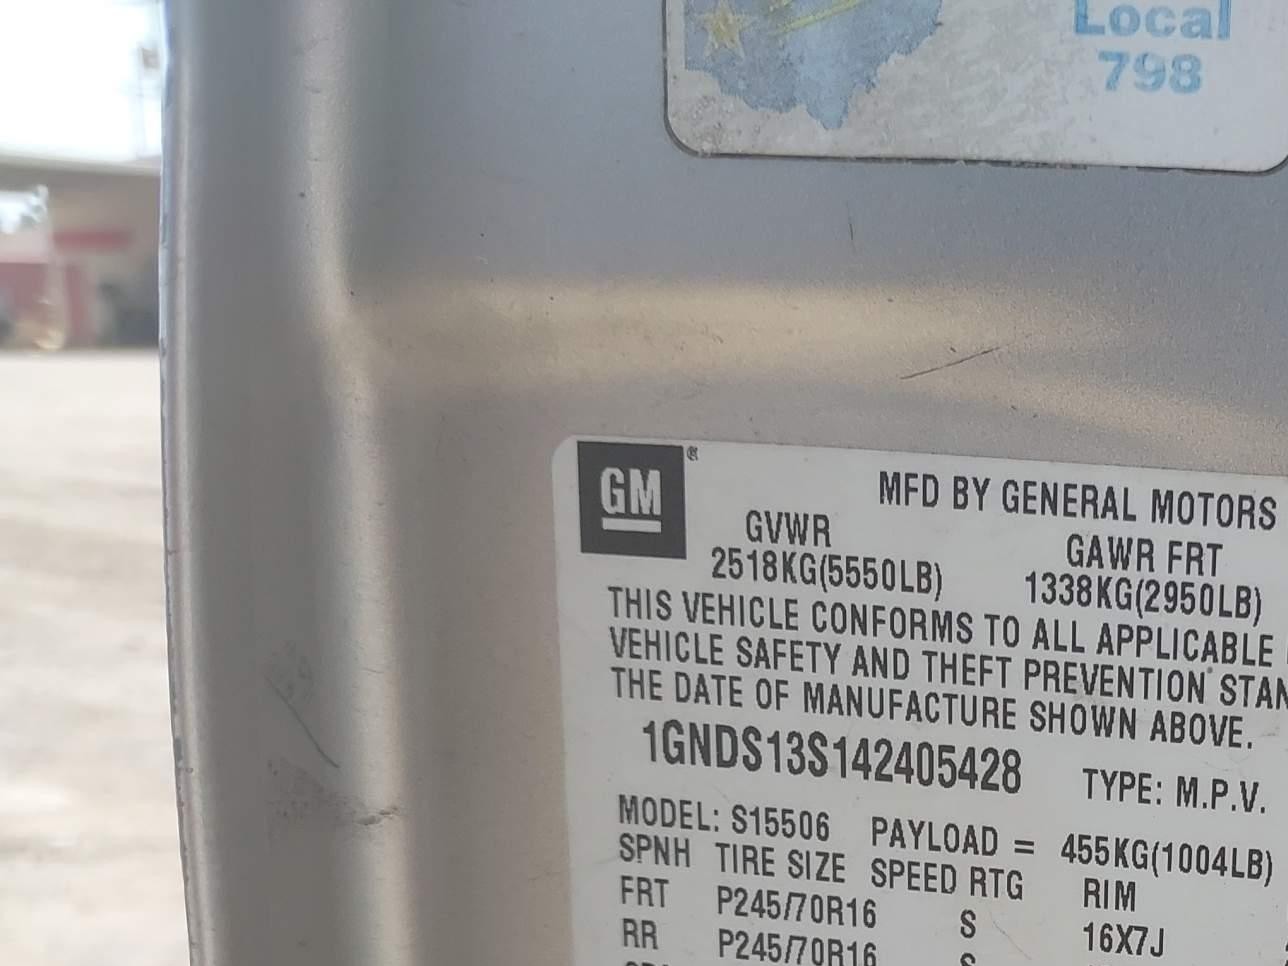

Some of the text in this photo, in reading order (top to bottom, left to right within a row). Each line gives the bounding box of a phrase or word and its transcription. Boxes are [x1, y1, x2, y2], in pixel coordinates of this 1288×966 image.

[1075, 0, 1231, 40] Local
[1098, 50, 1202, 94] 798
[600, 467, 662, 516] GM
[880, 471, 939, 507] MFD
[954, 476, 990, 511] BY
[1003, 480, 1136, 521] GENERAL
[1152, 489, 1276, 530] MOTORS
[746, 510, 831, 547] GVWR
[1067, 534, 1223, 576] GAWR FRT
[712, 547, 942, 601] 2518KG(5550LB)
[1025, 571, 1261, 627] 1338KG(2950LB)
[608, 586, 671, 620] THIS
[682, 591, 798, 630] VEHICLE
[812, 601, 972, 644] CONFORMS
[984, 614, 1019, 647] TO
[1033, 618, 1084, 653] ALL
[1097, 623, 1273, 667] APPLICABLE
[610, 627, 723, 665] VEHICLE
[737, 636, 841, 674] SAFETY
[852, 646, 909, 680] AND
[922, 651, 1011, 688] THEFT
[1025, 659, 1204, 703] PREVENTION
[611, 667, 1252, 749] THE DATE OF MANUFACTURE SHOWN ABOVE.
[643, 720, 1021, 794] 1GNDS13S142405428
[1083, 768, 1265, 814] TYPE: M.P.V.
[619, 794, 718, 832] MODEL:
[732, 804, 829, 841] S15506
[872, 816, 997, 856] PAYLOAD
[1061, 834, 1272, 887] 455KG(1004LB)
[619, 833, 690, 867] SPNH
[715, 843, 774, 876] TIRE
[788, 850, 845, 883] SIZE
[871, 858, 956, 894] SPEED
[971, 867, 1022, 900] RTG
[1084, 878, 1135, 911] RIM
[621, 875, 669, 907] FRT
[718, 885, 876, 928] P245/70R16
[960, 910, 976, 938] S
[1083, 922, 1164, 957] 16X7J
[623, 918, 657, 949] RR
